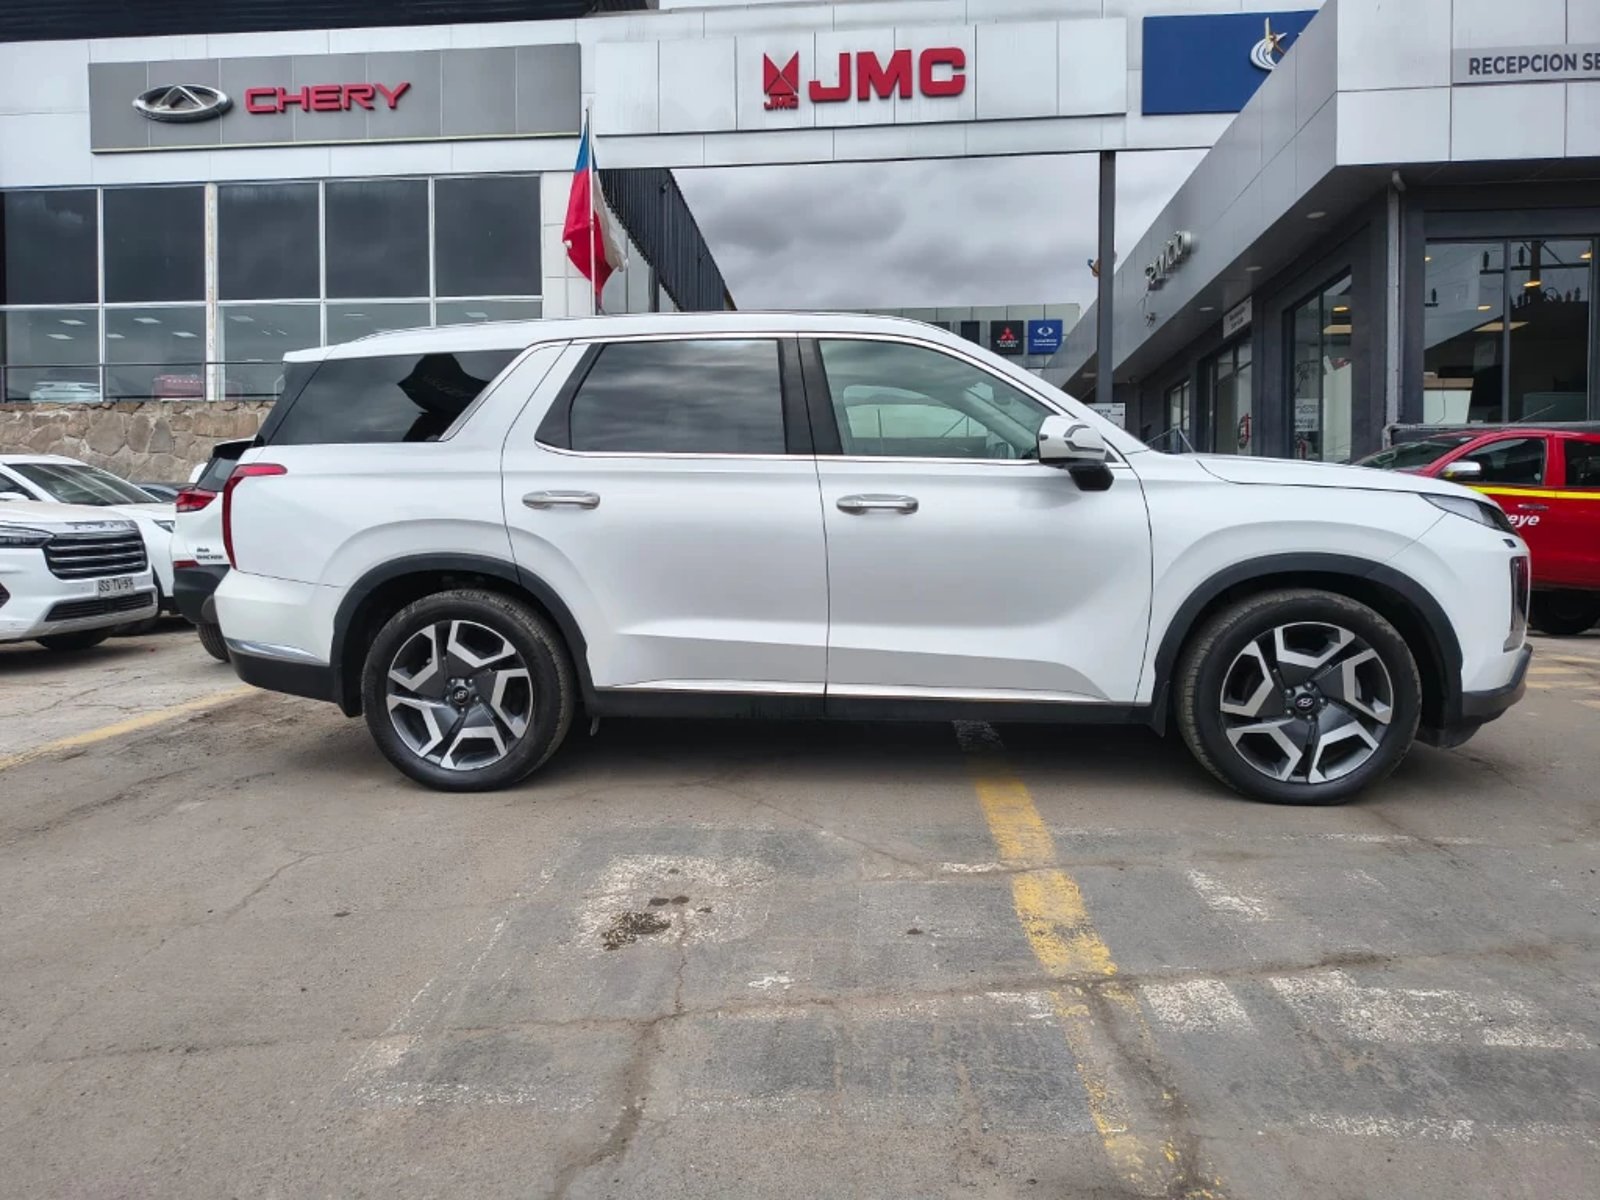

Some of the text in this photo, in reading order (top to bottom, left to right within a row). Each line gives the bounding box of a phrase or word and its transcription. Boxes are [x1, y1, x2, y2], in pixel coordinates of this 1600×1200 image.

[809, 47, 966, 103] JMC
[1468, 53, 1577, 76] RECEPCION
[244, 82, 410, 113] CHERY
[764, 95, 799, 110] JMC
[1506, 514, 1540, 528] eye
